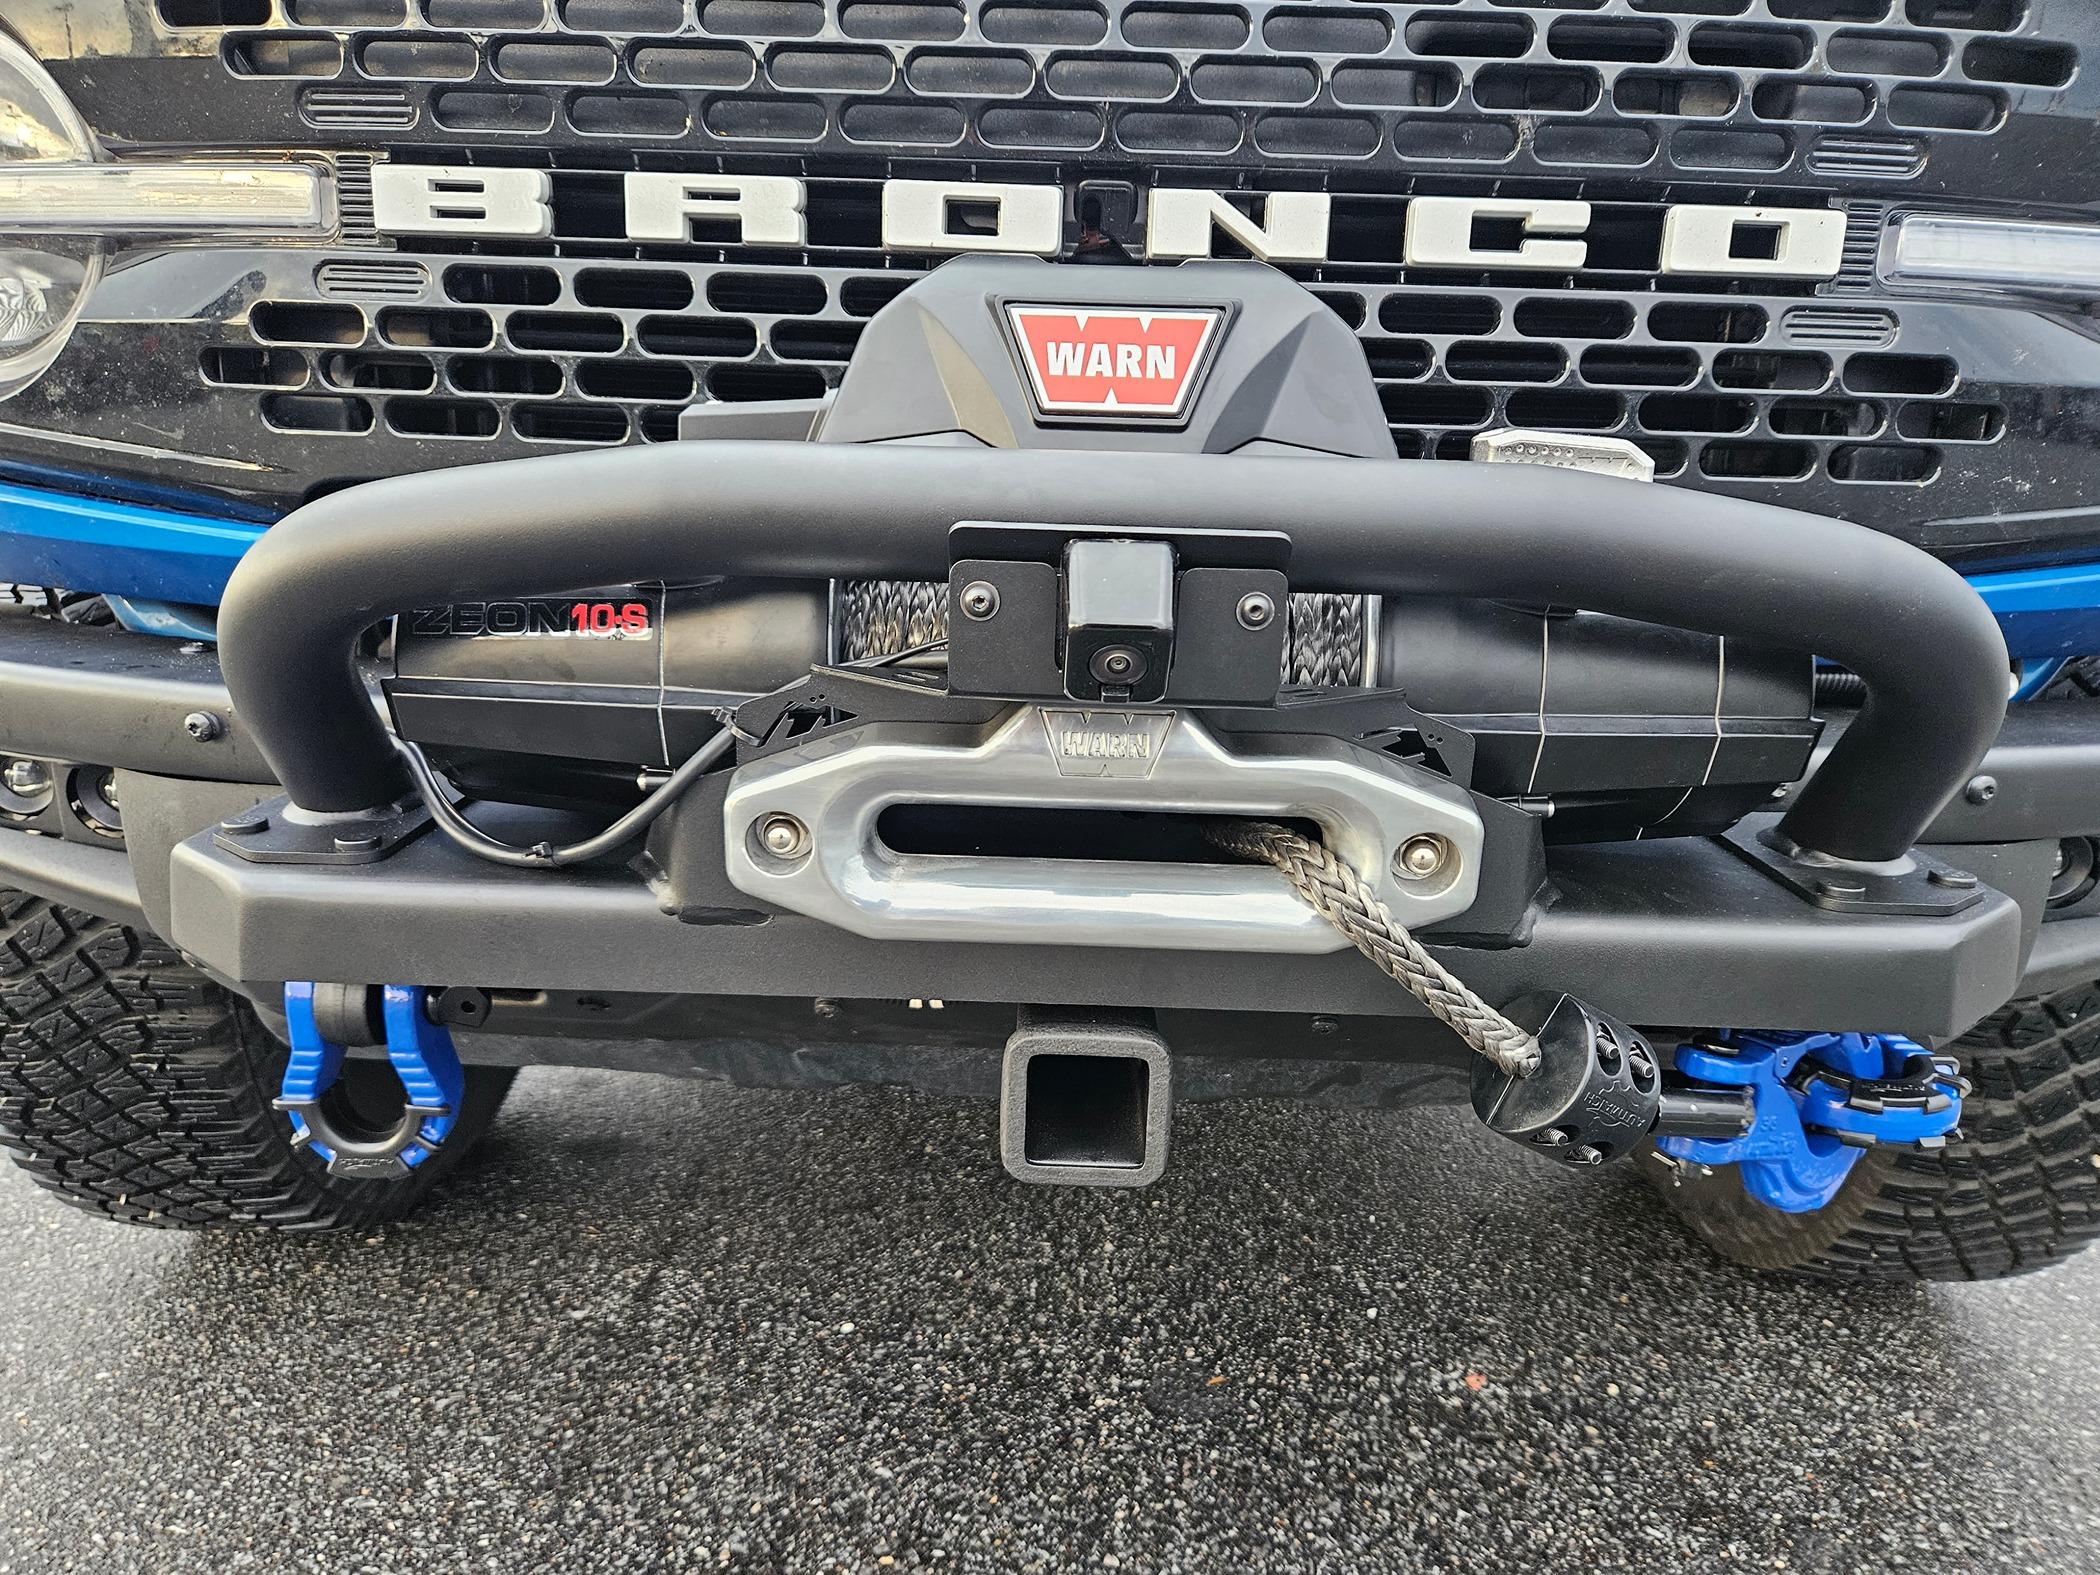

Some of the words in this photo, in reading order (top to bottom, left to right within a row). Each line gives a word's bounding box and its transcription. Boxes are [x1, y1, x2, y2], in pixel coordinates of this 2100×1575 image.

[371, 163, 1849, 278] BRONCO
[1046, 341, 1176, 380] WARN
[1061, 731, 1150, 758] WARN
